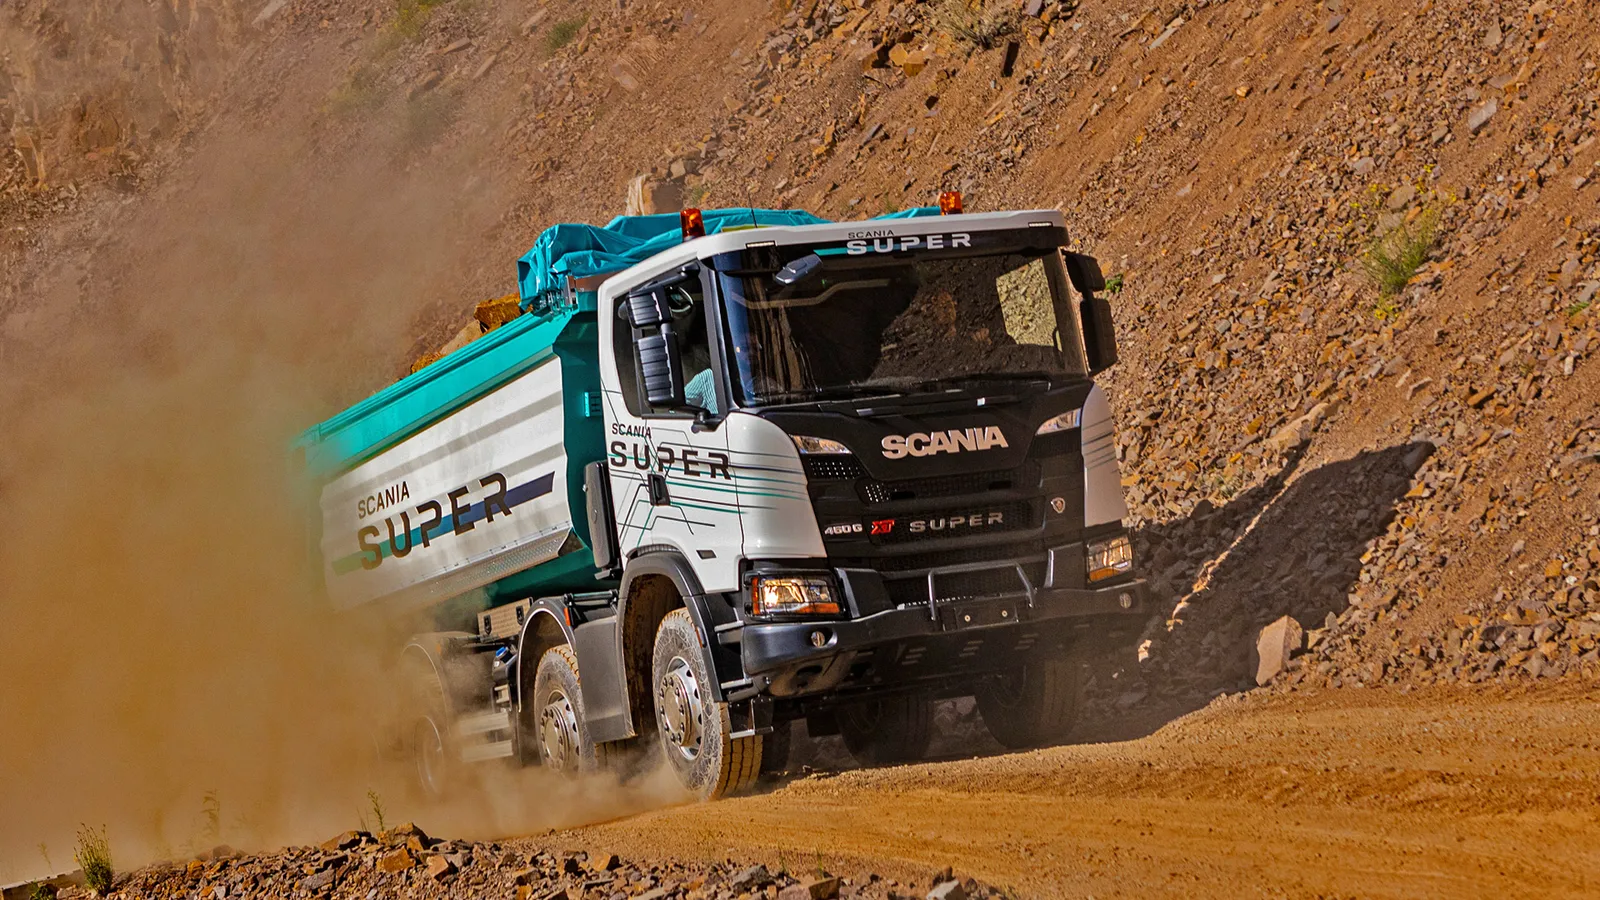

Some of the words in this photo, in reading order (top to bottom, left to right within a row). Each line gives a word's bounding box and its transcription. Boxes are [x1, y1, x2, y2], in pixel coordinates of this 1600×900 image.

[847, 233, 971, 255] SUPER
[848, 229, 895, 239] SCANIA
[612, 423, 652, 439] SCANIA
[881, 426, 1009, 460] SCANIA
[610, 440, 732, 480] SUPER
[357, 480, 410, 520] SCANIA
[357, 472, 513, 571] SUPER
[871, 519, 895, 535] XT
[909, 512, 1004, 533] SUPER
